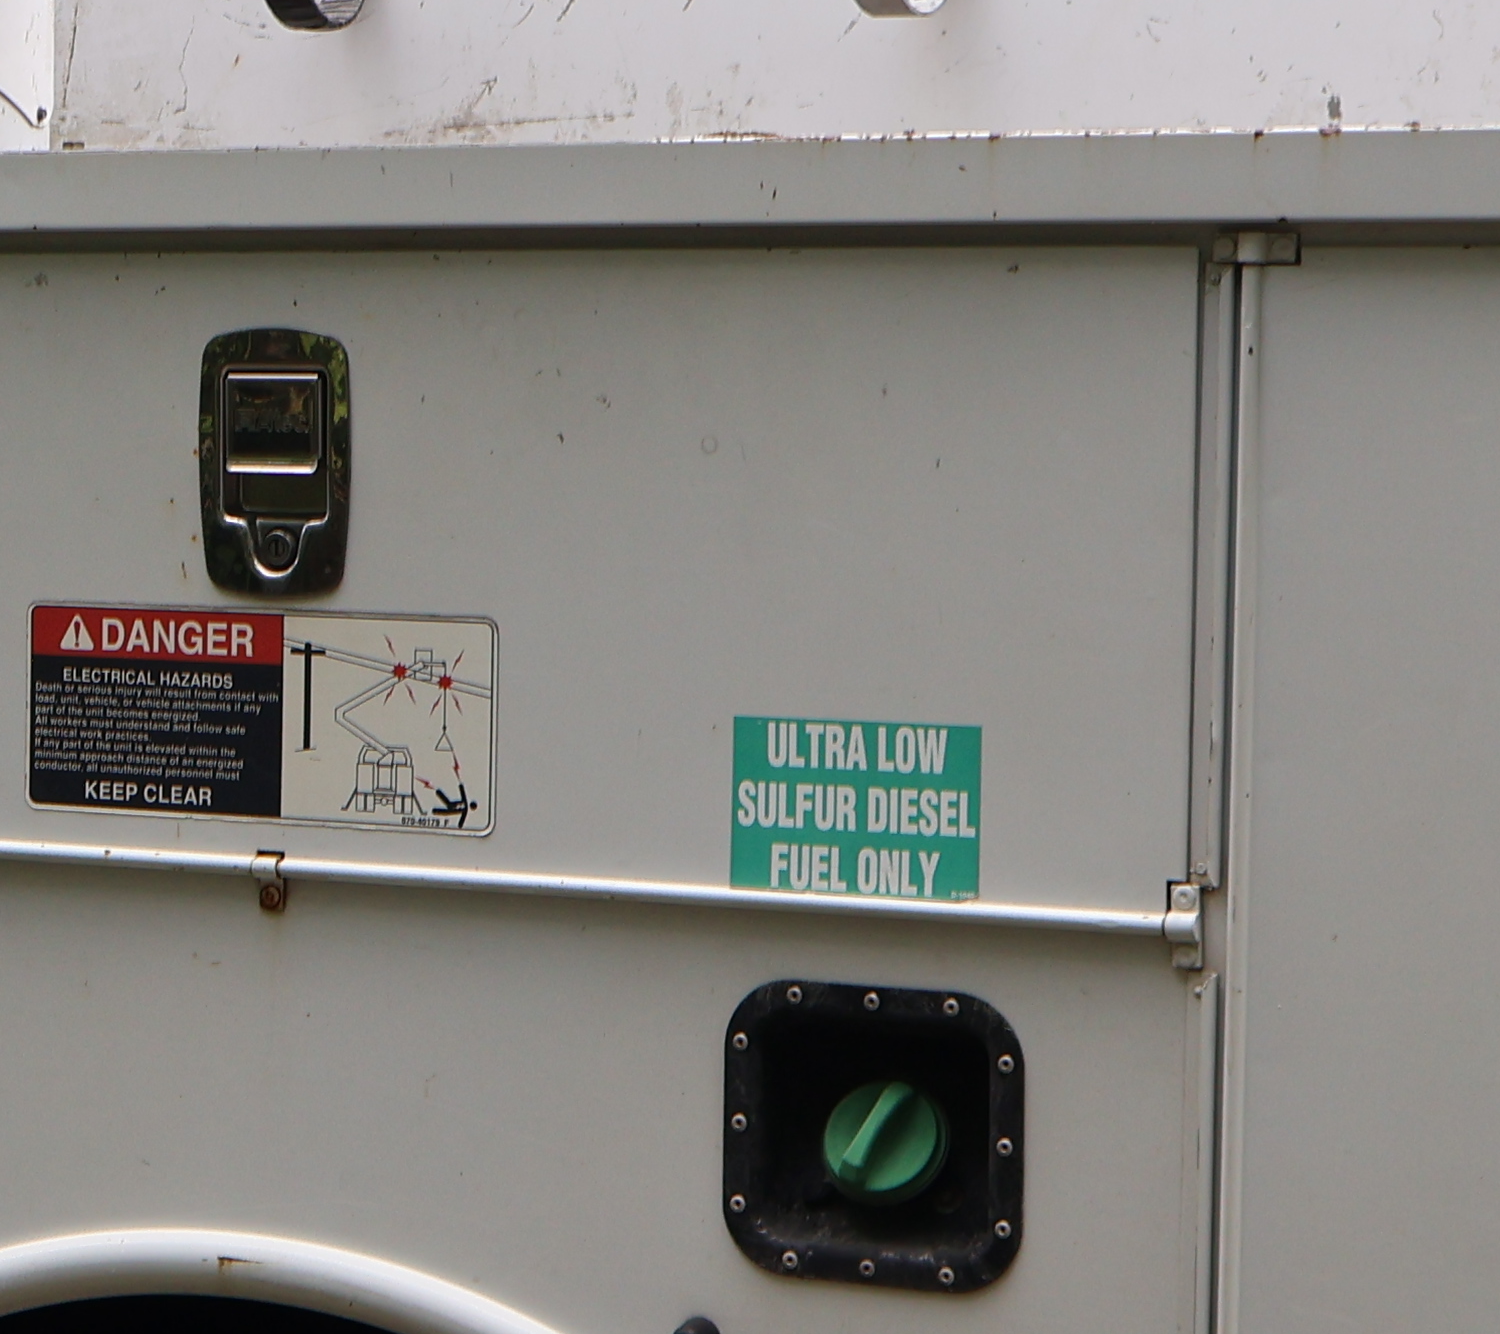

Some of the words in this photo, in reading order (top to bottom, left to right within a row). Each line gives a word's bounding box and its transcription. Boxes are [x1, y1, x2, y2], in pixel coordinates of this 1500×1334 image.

[102, 617, 254, 657] DANGER
[63, 667, 155, 685] ELECTRICAL
[160, 672, 233, 689] HAZARDS
[35, 682, 62, 692] Death
[77, 684, 112, 693] serious
[115, 684, 143, 697] injury
[145, 685, 161, 696] will
[164, 689, 191, 698] result
[194, 690, 216, 699] from
[220, 691, 255, 701] contact
[258, 691, 278, 703] with
[35, 694, 58, 703] load,
[61, 695, 80, 704] unit,
[85, 696, 119, 706] vehicle,
[136, 697, 169, 708] vehicle
[172, 699, 231, 711] attachments
[234, 703, 241, 712] if
[243, 704, 261, 715] any
[35, 706, 53, 715] part
[56, 706, 65, 714] of
[68, 707, 82, 715] the
[85, 707, 103, 716] unit
[106, 708, 148, 718] becomes
[152, 710, 200, 722] energized.
[35, 716, 48, 725] All
[50, 717, 87, 727] workers
[90, 718, 113, 728] must
[116, 719, 169, 731] understand
[172, 724, 190, 733] and
[193, 723, 222, 733] follow
[225, 724, 245, 735] safe
[35, 728, 77, 738] electrical
[80, 731, 102, 739] work
[105, 732, 151, 742] practices.
[35, 737, 41, 747] If
[43, 739, 60, 749] any
[63, 740, 81, 750] part
[84, 741, 93, 749] of
[96, 741, 111, 751] the
[114, 743, 132, 751] unit
[135, 743, 143, 752] is
[145, 743, 186, 755] elevated
[189, 747, 218, 756] within
[220, 747, 236, 757] the
[767, 721, 867, 771] ULTRA
[878, 726, 948, 774] LOW
[35, 749, 77, 759] minimum
[80, 752, 123, 762] approach
[126, 754, 166, 765] distance
[170, 757, 179, 765] of
[182, 758, 194, 766] an
[196, 759, 243, 770] energized
[34, 760, 83, 772] conductor,
[86, 763, 98, 772] all
[100, 763, 162, 776] unauthorized
[165, 769, 213, 779] personnel
[216, 770, 240, 781] must
[85, 779, 138, 801] KEEP
[143, 783, 212, 806] CLEAR
[738, 780, 857, 832] SULFUR
[867, 786, 976, 838] DIESEL
[770, 842, 847, 892] FUEL
[857, 846, 940, 898] ONLY
